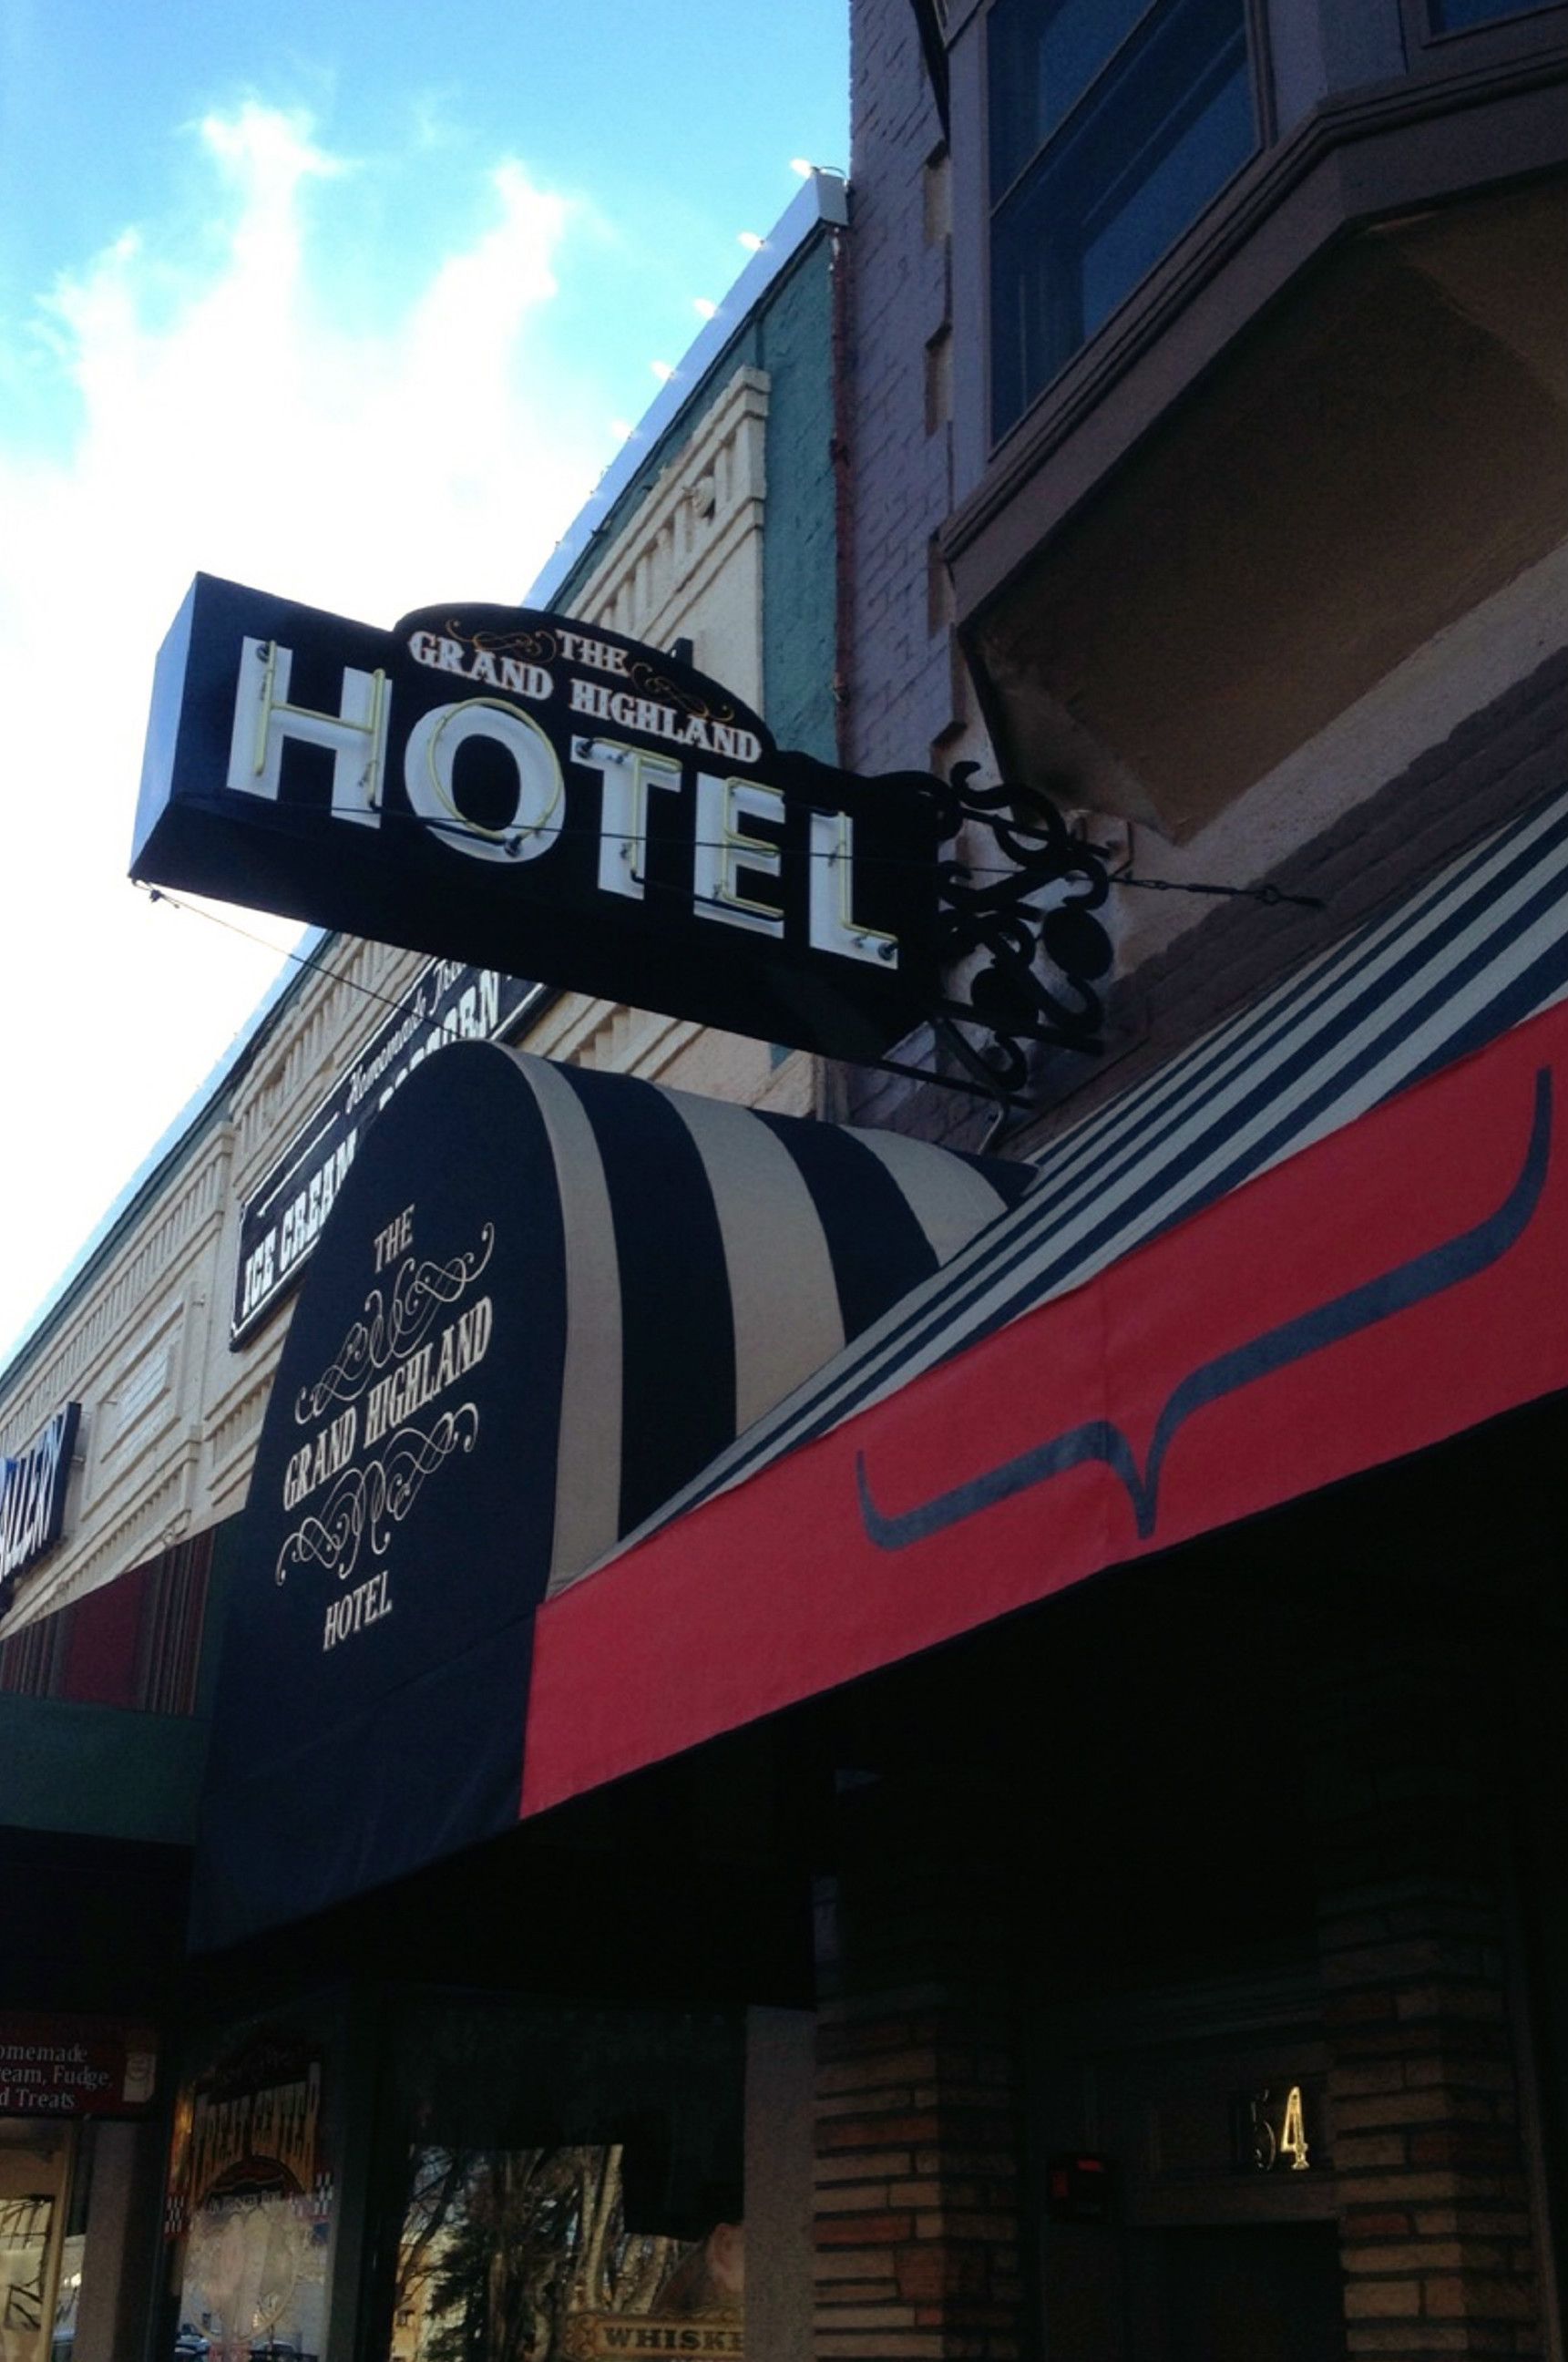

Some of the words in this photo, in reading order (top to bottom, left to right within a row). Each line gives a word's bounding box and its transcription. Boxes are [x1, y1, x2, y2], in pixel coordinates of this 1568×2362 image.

[556, 629, 630, 678] THE
[407, 631, 553, 701] GRAND
[569, 678, 763, 763] HIGHLAND
[226, 635, 900, 970] HOTEL
[242, 1227, 276, 1319] ICE
[374, 1204, 415, 1274] THE
[284, 1406, 356, 1511] GRAND
[364, 1296, 492, 1450] HIGHLAND
[323, 1570, 393, 1652] HOTEL
[15, 2088, 77, 2110] Treats
[53, 2063, 114, 2092] Fudge,
